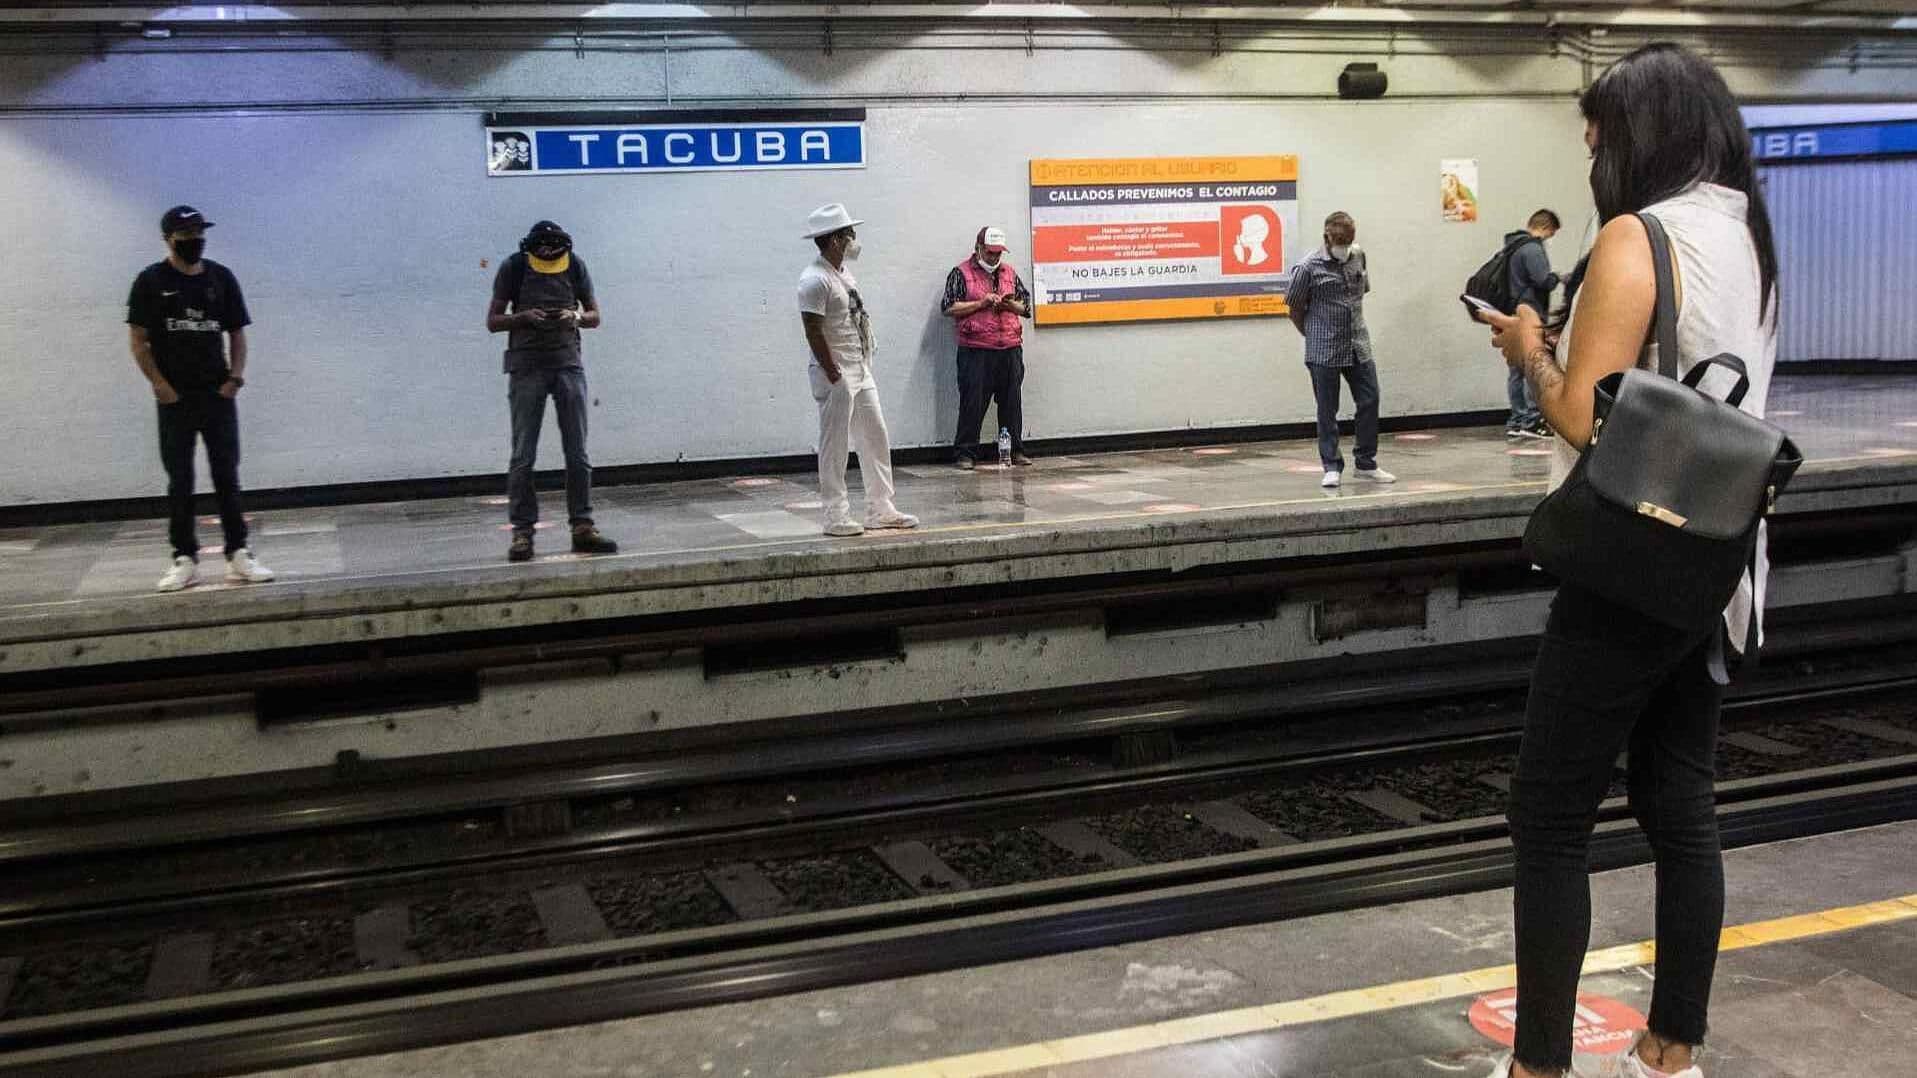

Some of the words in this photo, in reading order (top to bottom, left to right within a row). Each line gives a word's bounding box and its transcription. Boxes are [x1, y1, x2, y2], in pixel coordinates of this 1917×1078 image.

[569, 130, 830, 166] TACUBA
[1049, 190, 1114, 202] CALLADOS
[1117, 187, 1193, 200] PREVENIMOS
[1199, 187, 1213, 197] EL
[1216, 185, 1277, 197] CONTAGIO
[1072, 269, 1089, 278] NO
[1092, 267, 1127, 277] BAJES
[1131, 266, 1144, 276] LA
[1148, 265, 1198, 275] GUARDIA
